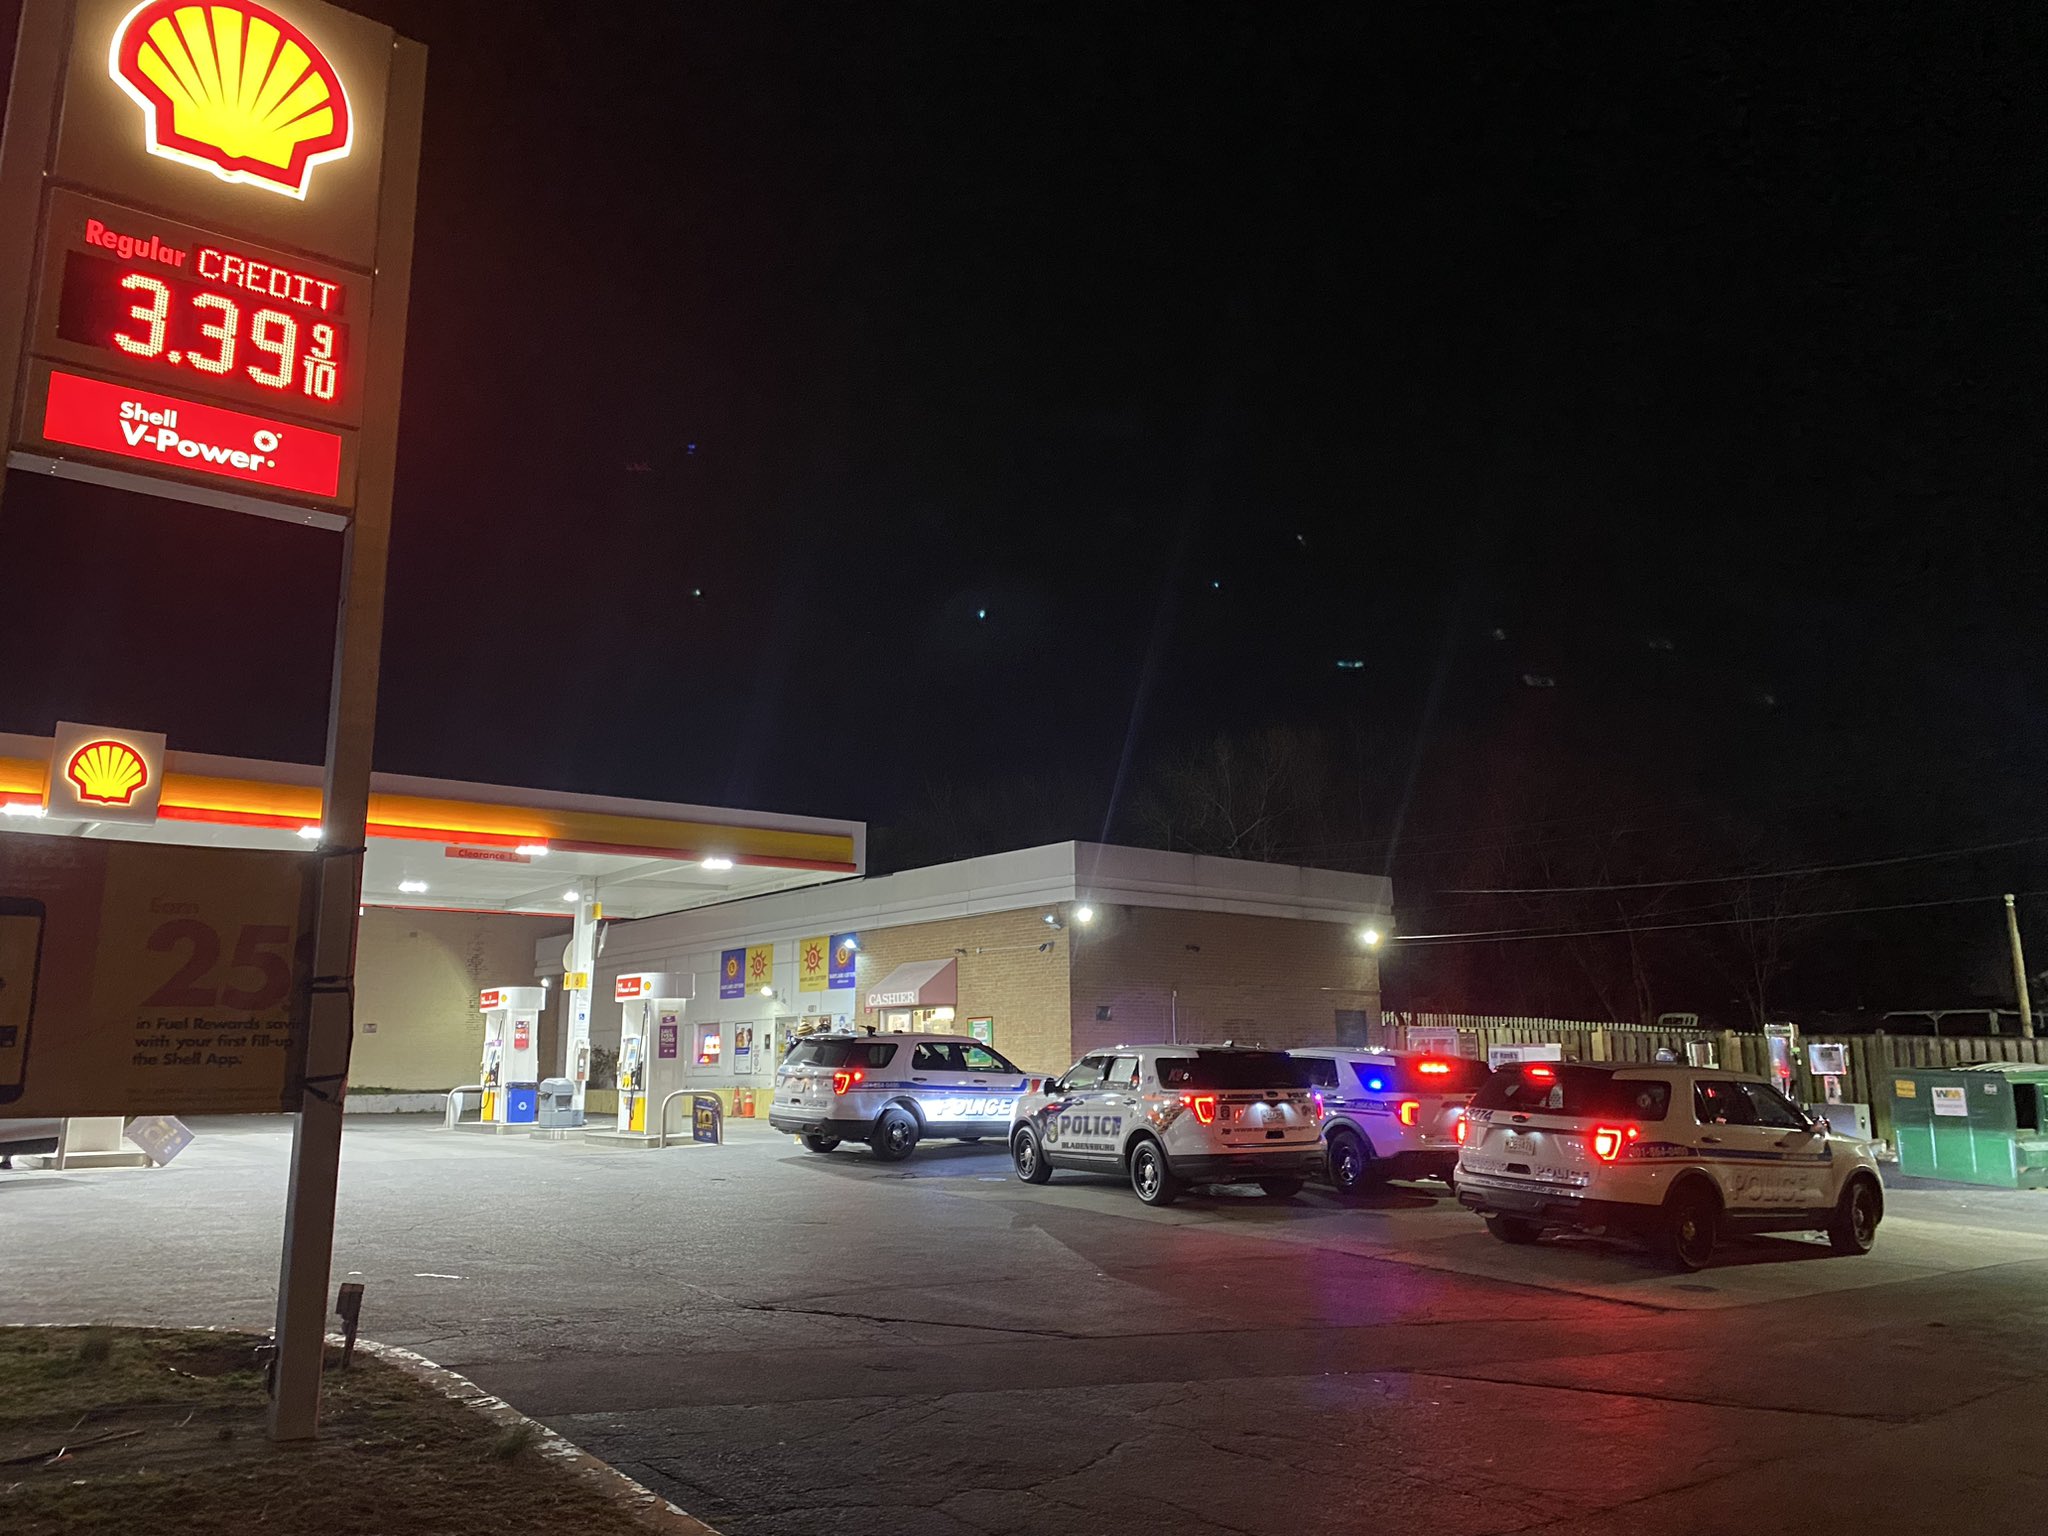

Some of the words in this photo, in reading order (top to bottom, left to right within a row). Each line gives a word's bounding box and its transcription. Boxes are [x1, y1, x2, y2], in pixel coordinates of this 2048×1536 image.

[85, 218, 186, 268] Regular
[199, 249, 340, 311] CREDIT
[113, 274, 298, 389] 3.39
[119, 401, 178, 428] Shell
[119, 419, 265, 471] V-Power
[458, 849, 505, 860] Clearance
[150, 896, 200, 914] Earn
[138, 919, 291, 1011] 25
[868, 991, 915, 1006] CASHIER
[135, 1016, 151, 1030] in
[156, 1017, 189, 1030] Fuel
[192, 1017, 261, 1031] Rewards
[134, 1034, 170, 1048] with
[175, 1036, 213, 1050] your
[216, 1034, 246, 1047] first
[250, 1034, 294, 1050] fill-up
[131, 1052, 158, 1066] the
[162, 1051, 202, 1066] Shell
[696, 1110, 713, 1123] 10
[936, 1097, 1014, 1117] POLICE
[1060, 1115, 1122, 1136] POLICE
[1061, 1141, 1116, 1152] BLADENSBURG
[1733, 1174, 1809, 1203] POLICE
